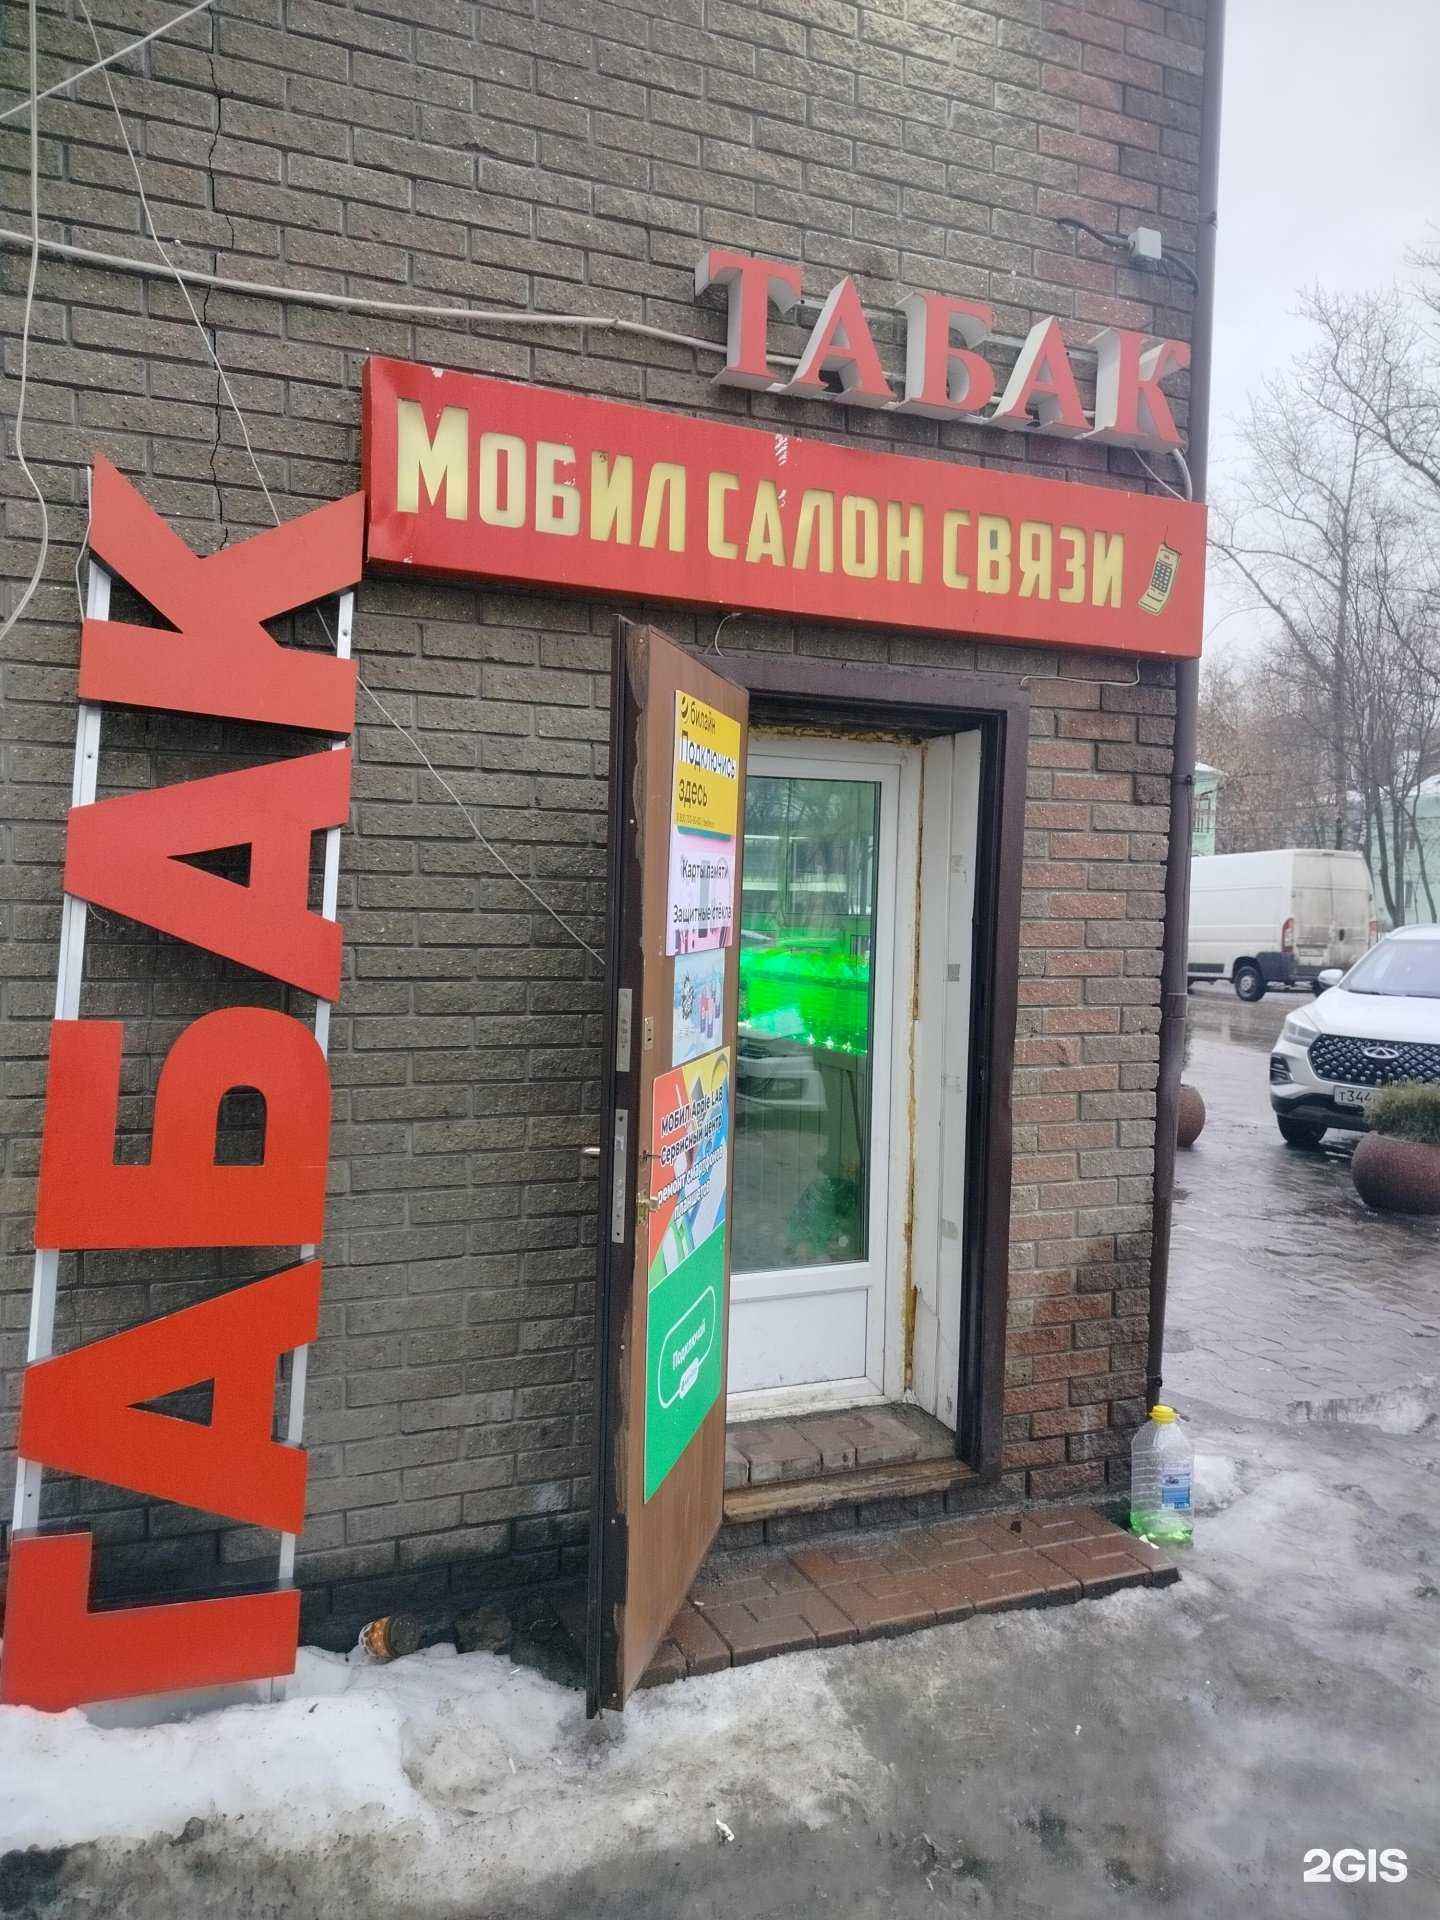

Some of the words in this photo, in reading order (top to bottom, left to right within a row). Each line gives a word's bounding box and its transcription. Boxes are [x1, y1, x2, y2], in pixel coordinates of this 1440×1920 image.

[697, 249, 1191, 452] ТАБАК
[706, 471, 926, 585] САЛОН
[941, 510, 1125, 609] СВЯЗИ
[680, 729, 736, 780] Подключись
[678, 778, 708, 809] здесь
[682, 859, 705, 881] Карты
[673, 904, 711, 924] Защитные
[661, 1105, 690, 1137] МОБИЛ
[691, 1095, 711, 1119] Apple
[711, 1086, 724, 1106] LAB
[660, 1126, 703, 1166] Сервисный
[703, 1115, 723, 1138] центр
[658, 1174, 686, 1205] ремонт
